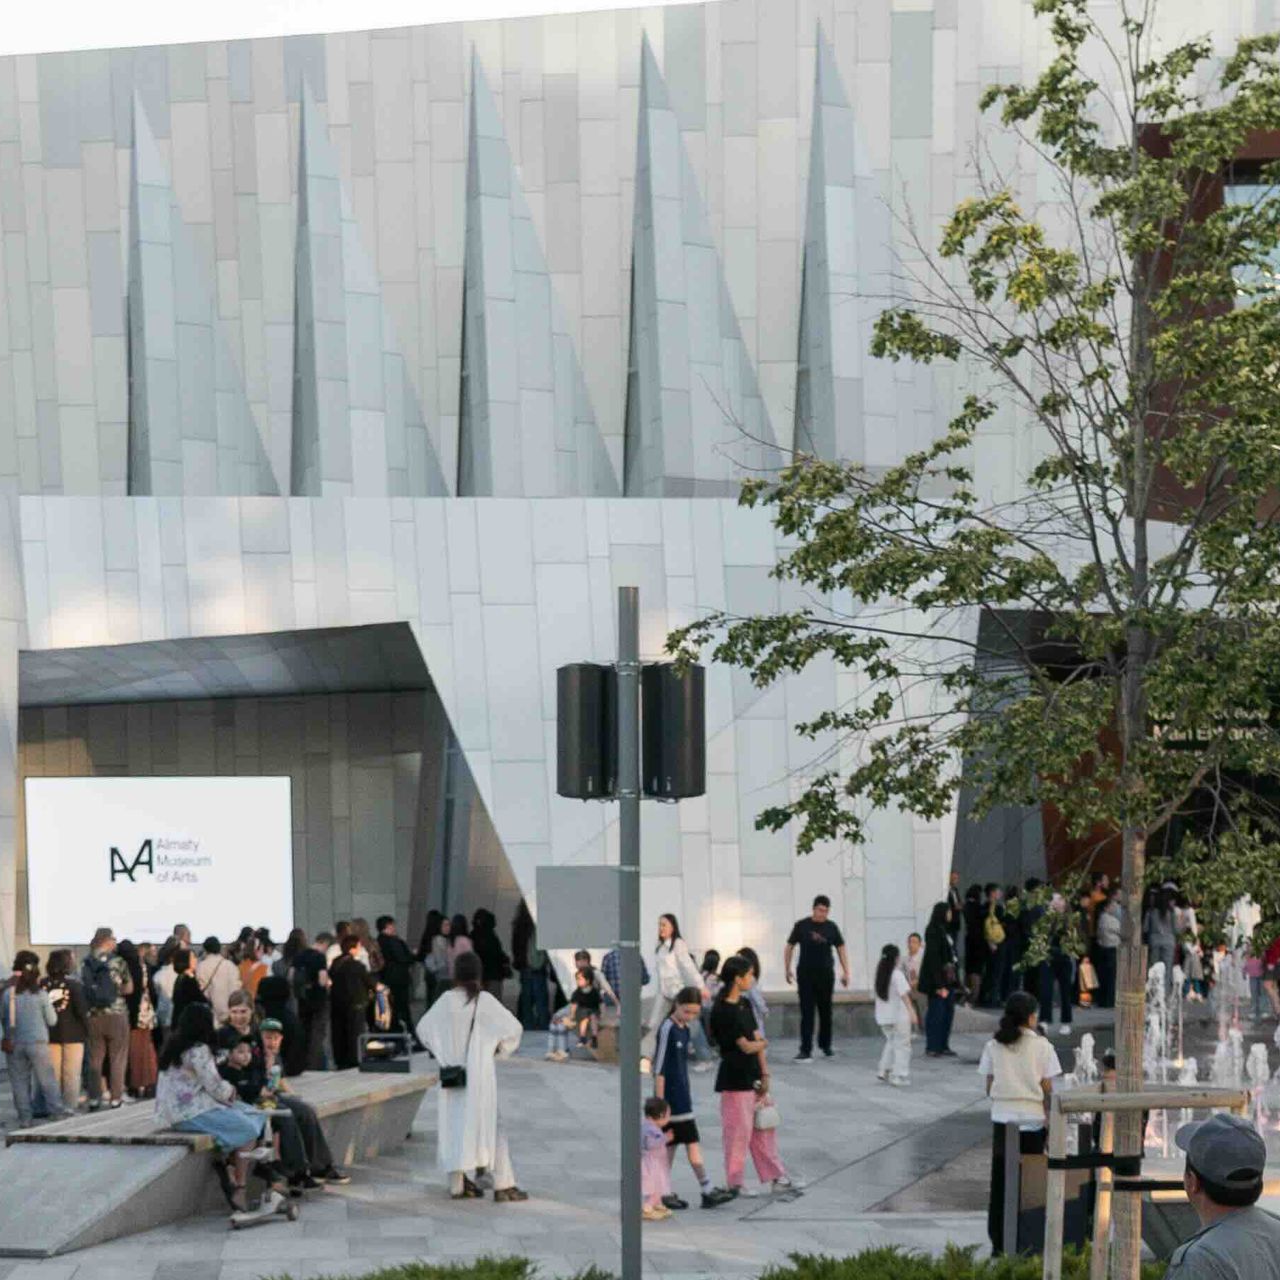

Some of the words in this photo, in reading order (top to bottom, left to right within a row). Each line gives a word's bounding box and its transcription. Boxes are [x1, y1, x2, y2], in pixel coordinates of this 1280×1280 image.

[157, 838, 199, 852] Almaty
[157, 854, 211, 866] Museum
[157, 871, 169, 882] of
[171, 871, 198, 882] Arts
